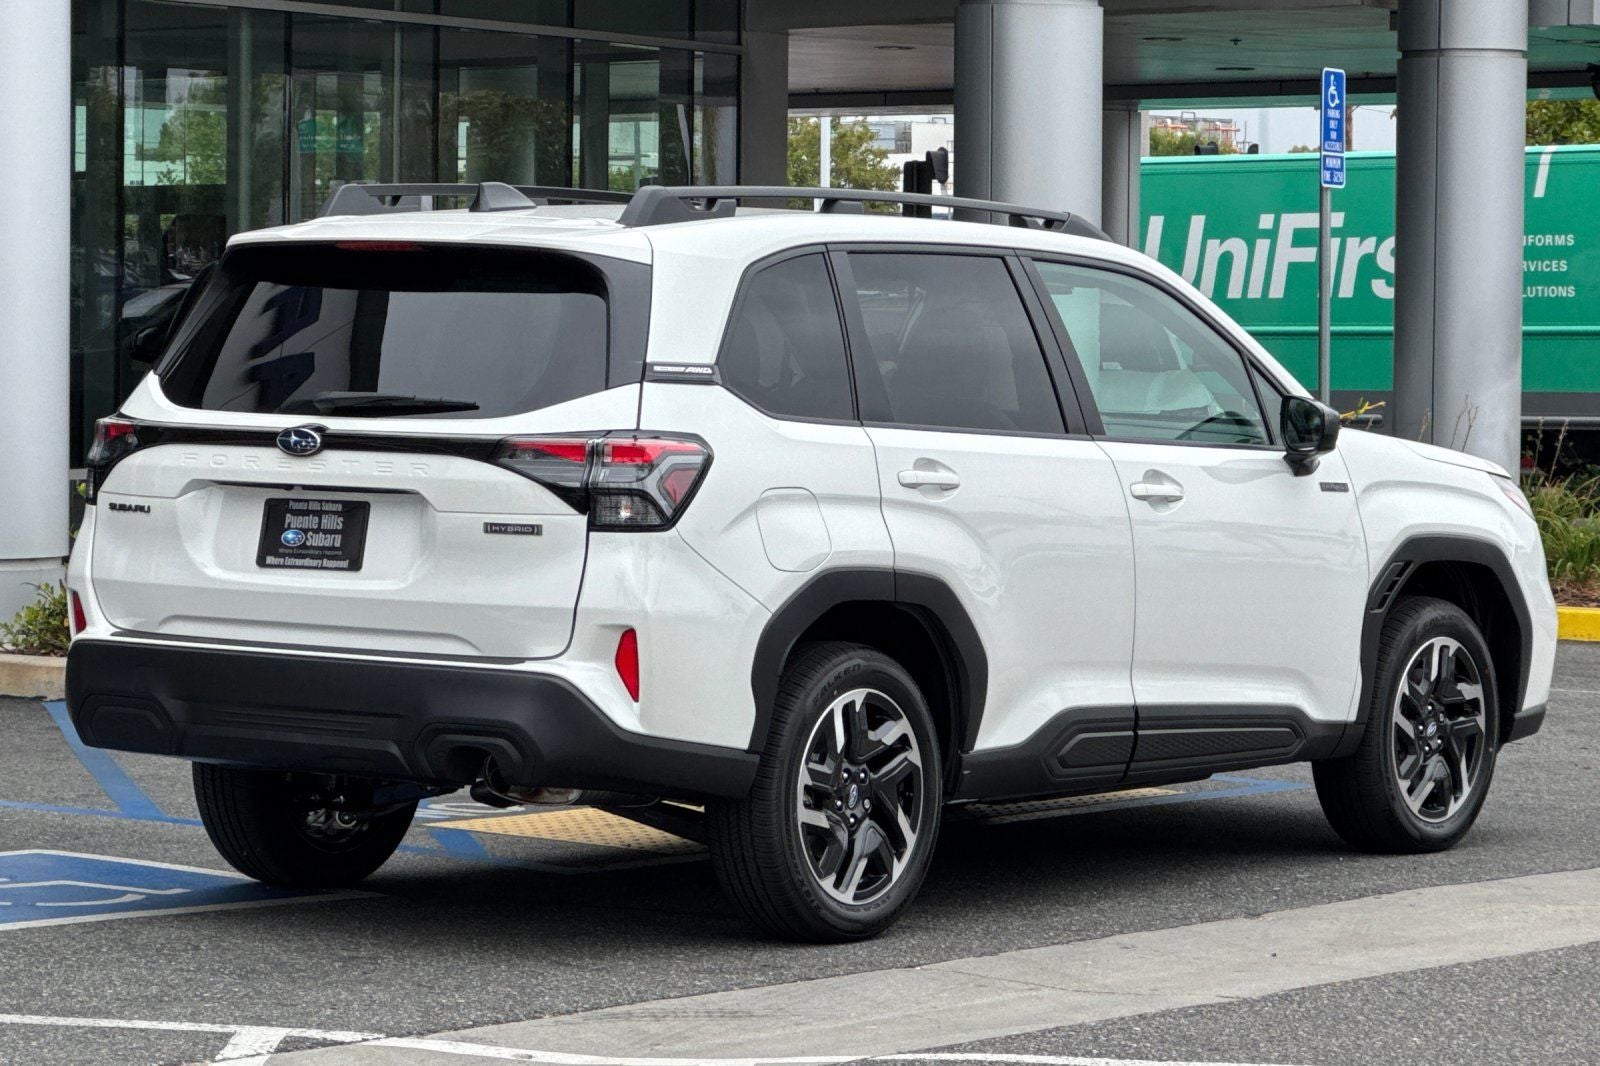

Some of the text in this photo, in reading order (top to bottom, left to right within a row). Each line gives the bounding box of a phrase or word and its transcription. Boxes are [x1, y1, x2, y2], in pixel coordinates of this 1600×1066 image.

[180, 452, 430, 477] FORESTER
[109, 502, 151, 513] SUBARU
[284, 514, 343, 530] Puente Hills
[492, 525, 533, 533] HYBRID
[305, 532, 341, 547] Subaru
[266, 556, 284, 565] Where
